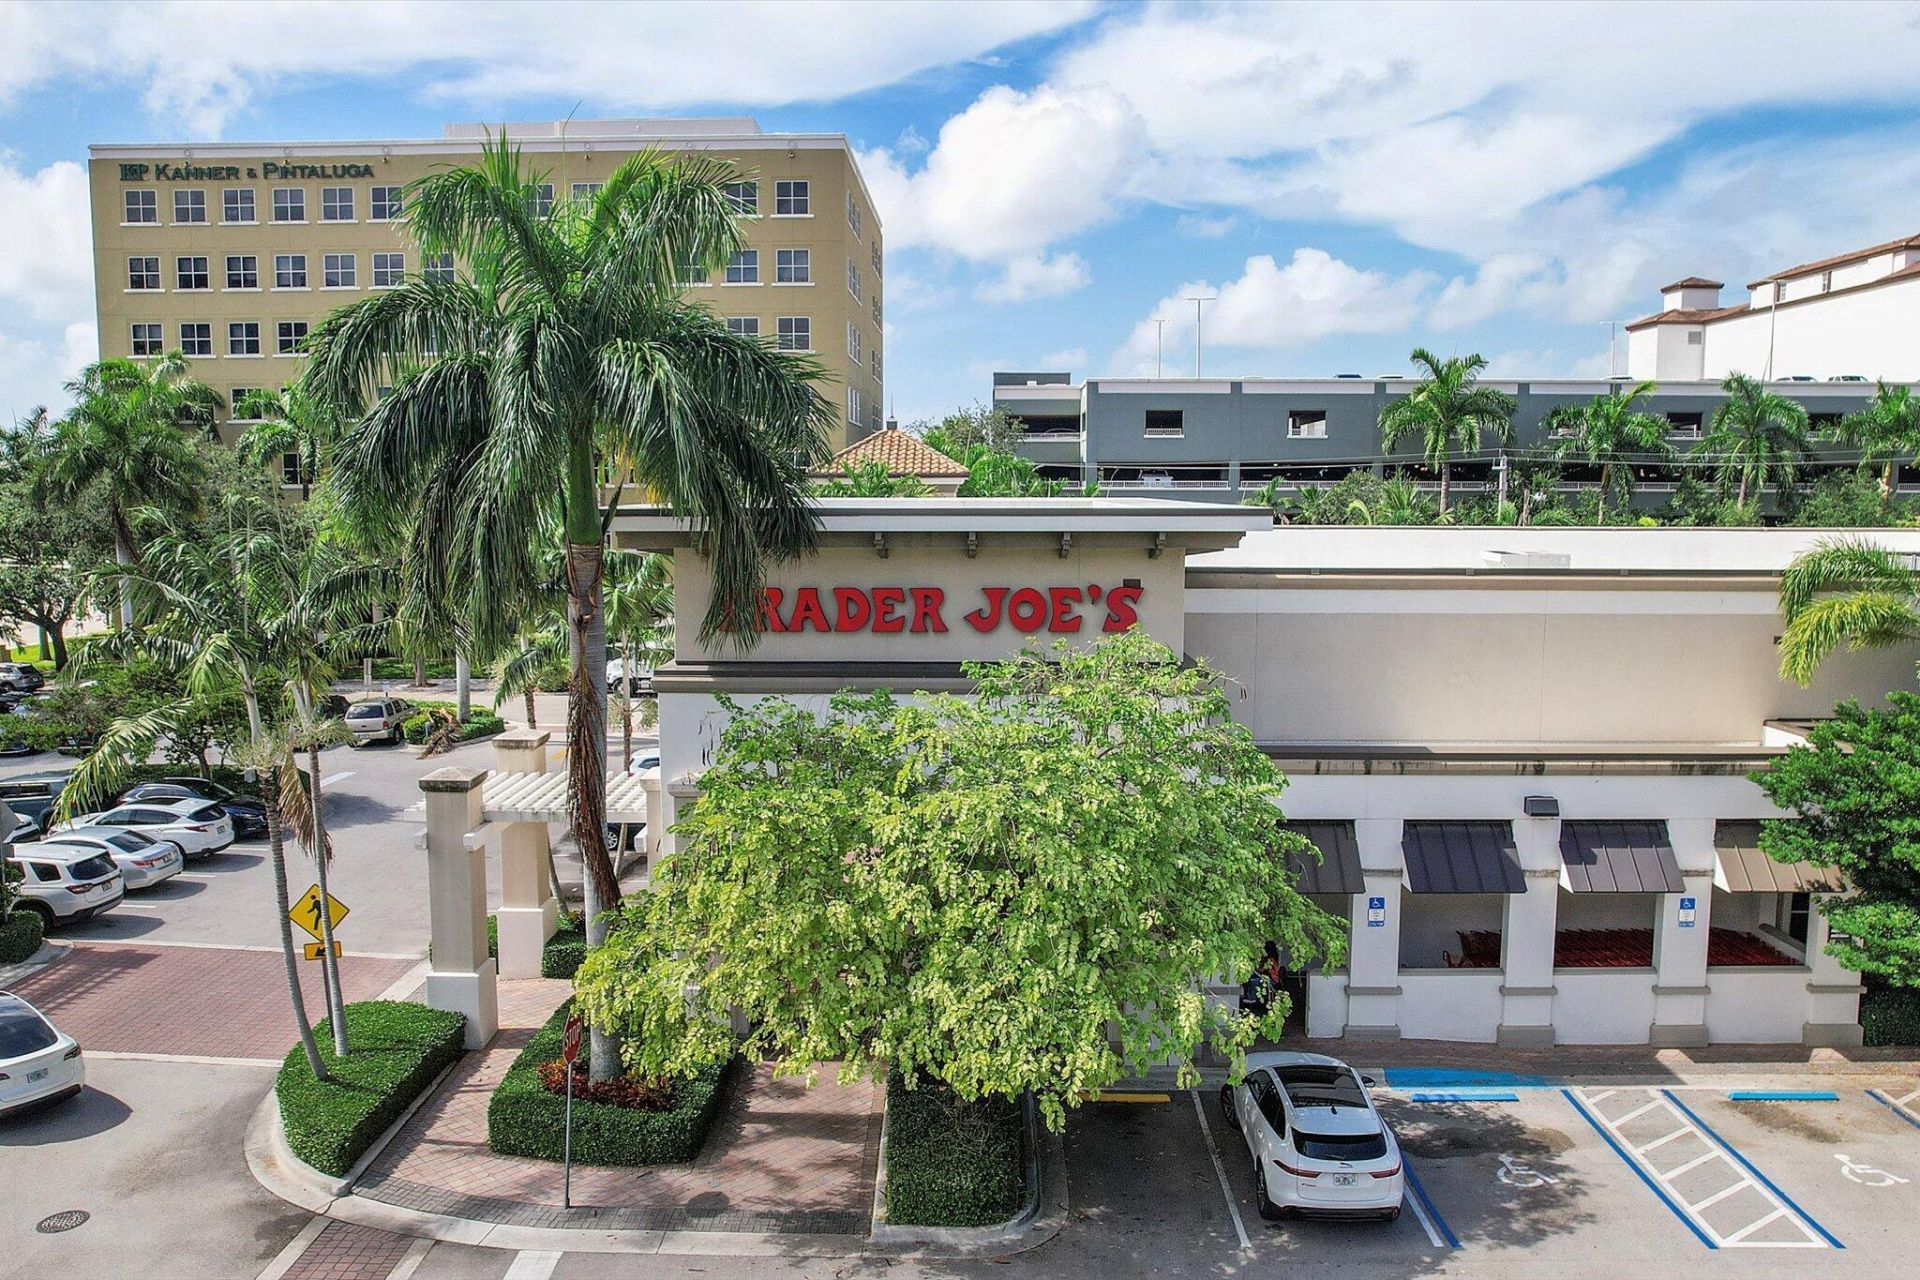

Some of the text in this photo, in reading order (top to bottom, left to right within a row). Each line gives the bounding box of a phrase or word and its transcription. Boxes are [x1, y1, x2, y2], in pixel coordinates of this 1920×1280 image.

[155, 163, 240, 181] KANNER
[246, 167, 258, 179] &
[263, 162, 374, 179] PINTALUGA
[963, 583, 1144, 633] JOE'S
[565, 1021, 580, 1051] STOP
